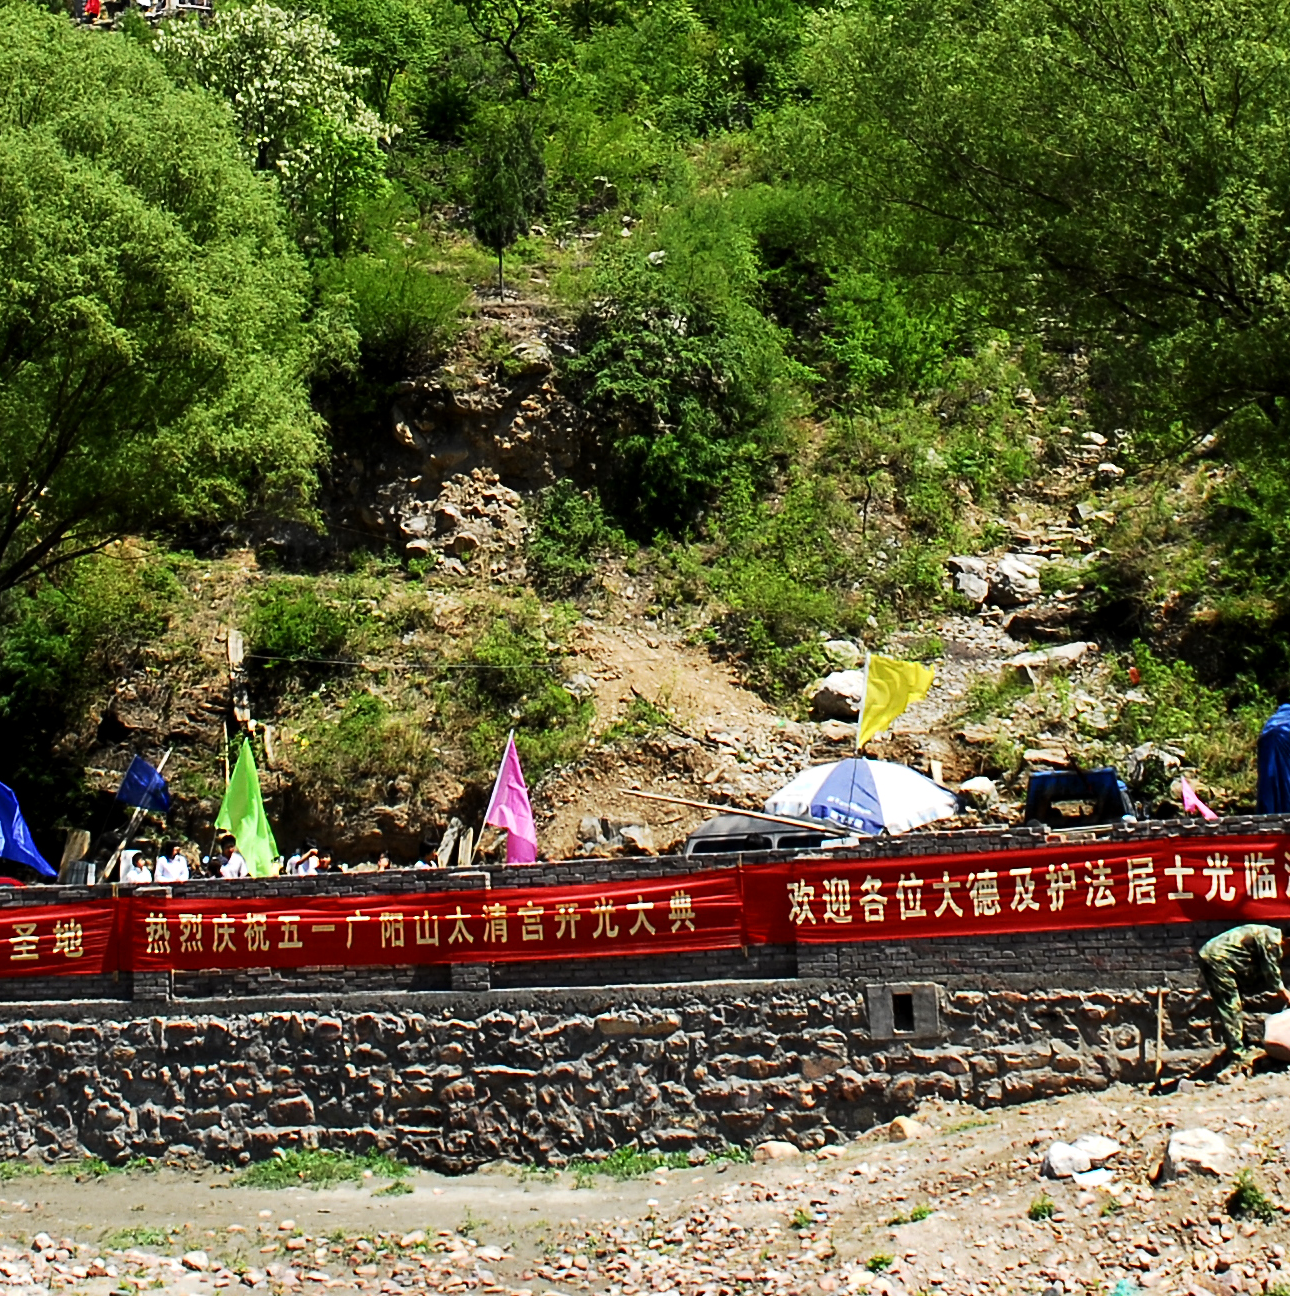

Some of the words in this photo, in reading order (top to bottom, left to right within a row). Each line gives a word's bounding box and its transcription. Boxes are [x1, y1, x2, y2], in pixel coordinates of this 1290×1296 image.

[145, 890, 696, 954] 热烈庆祝五一广阳山太清宫开光大典
